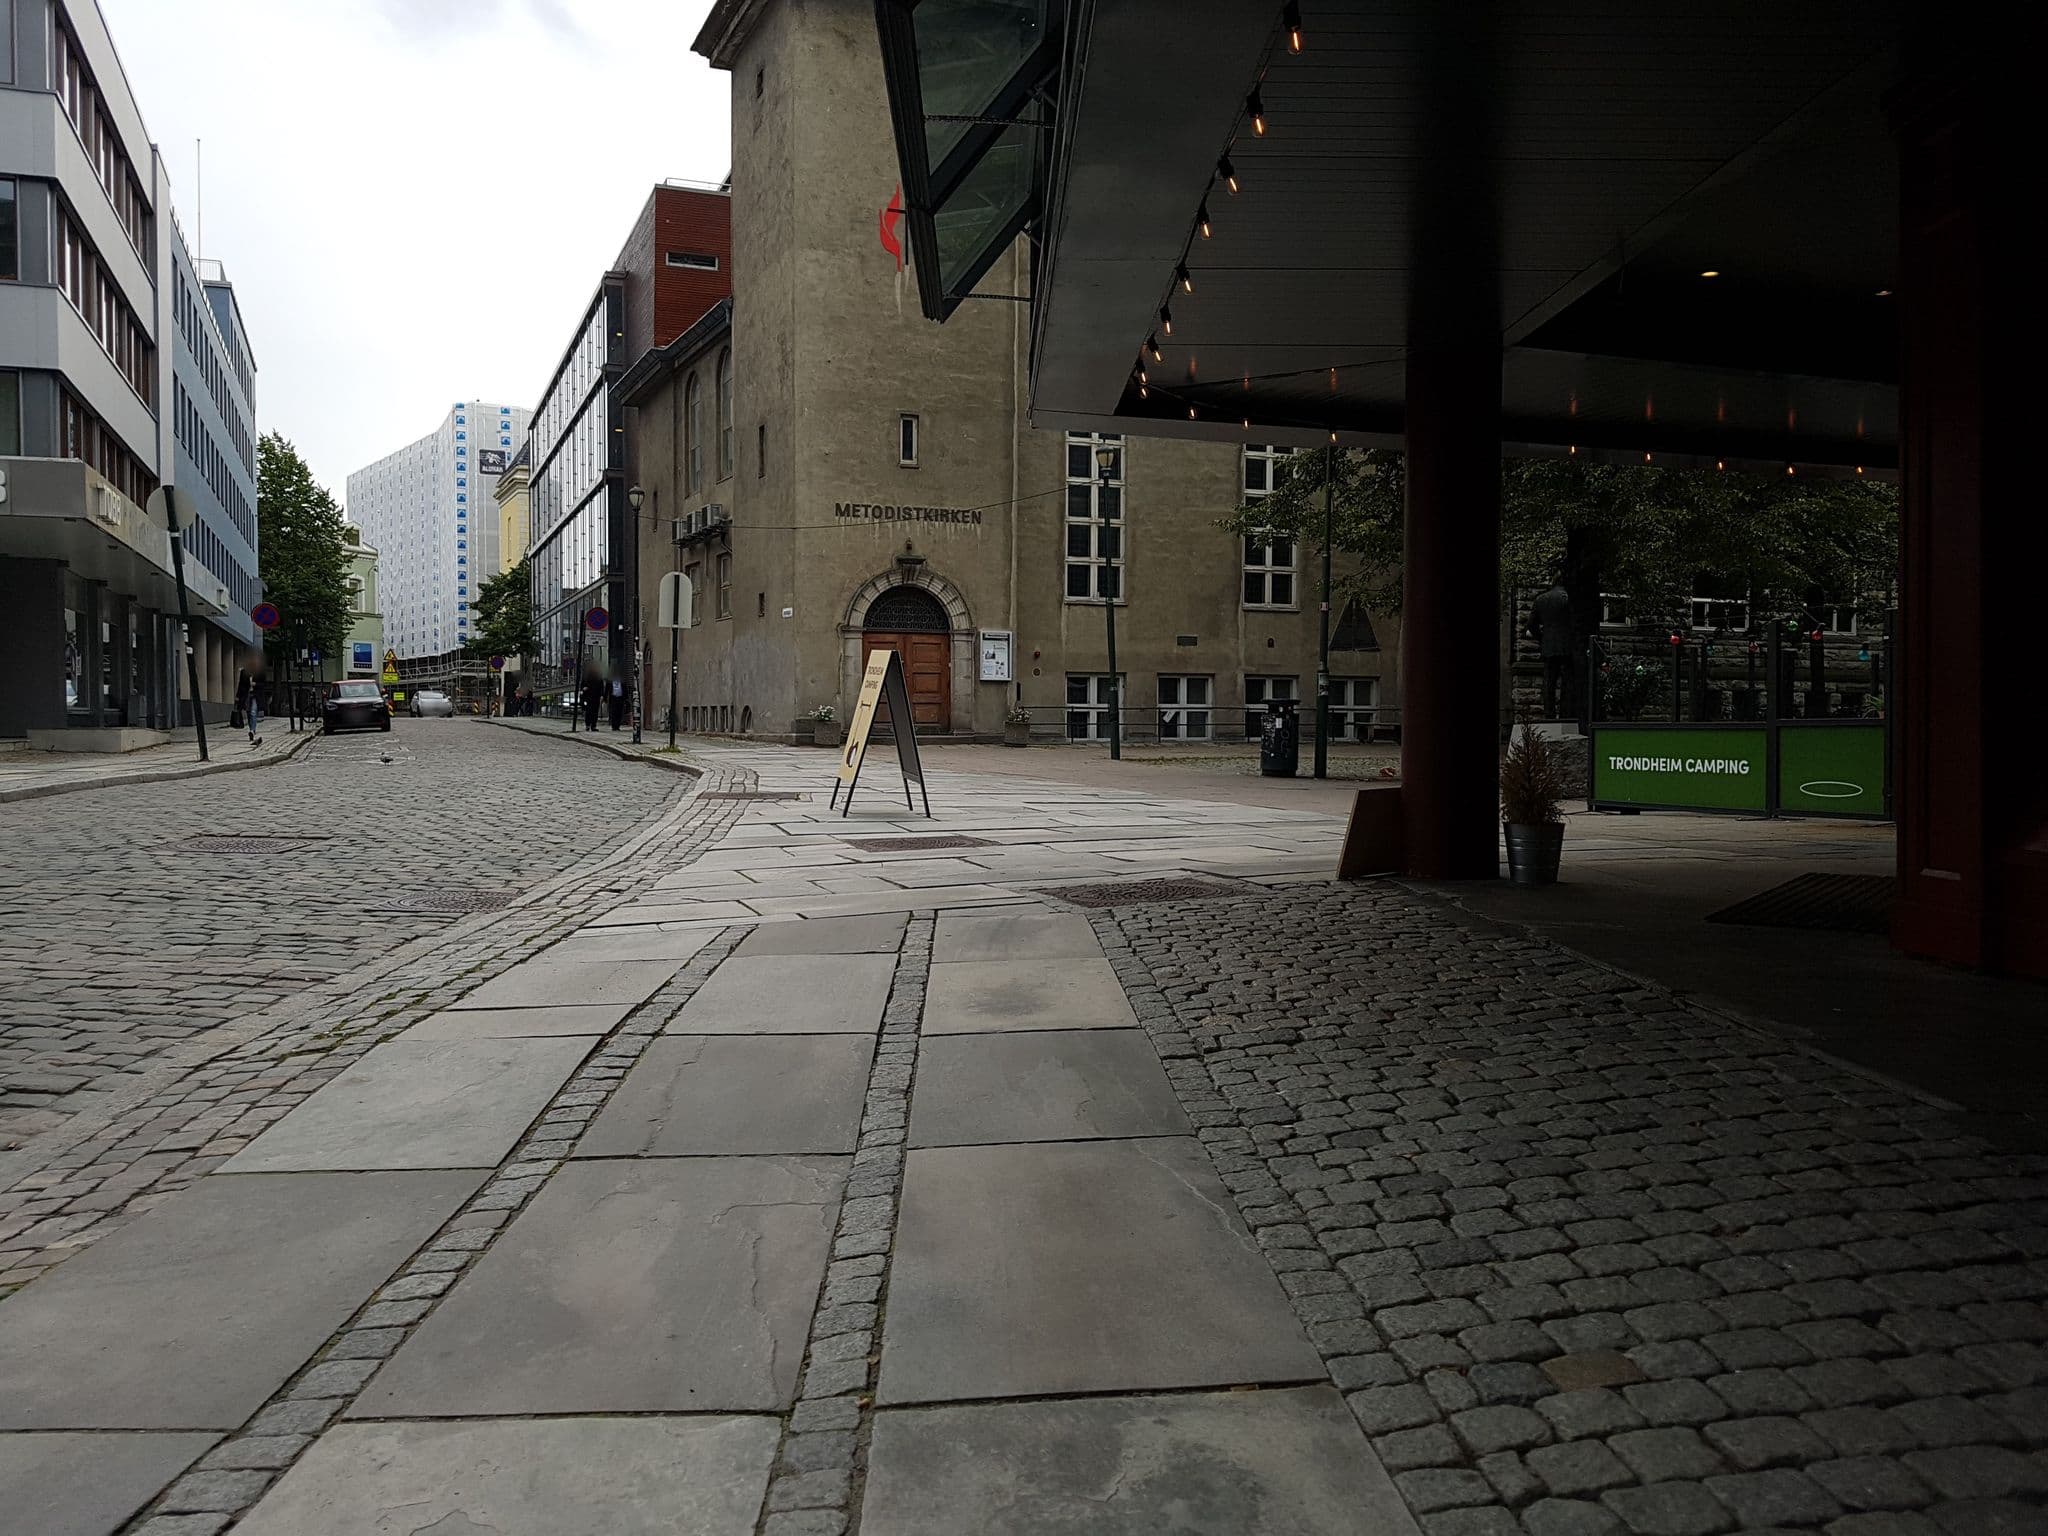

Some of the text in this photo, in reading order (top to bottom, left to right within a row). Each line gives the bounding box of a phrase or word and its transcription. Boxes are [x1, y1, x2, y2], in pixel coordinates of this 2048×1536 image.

[835, 503, 982, 525] METODISTKIRKEN
[1608, 756, 1750, 775] TRONDHEIM CAMPING
